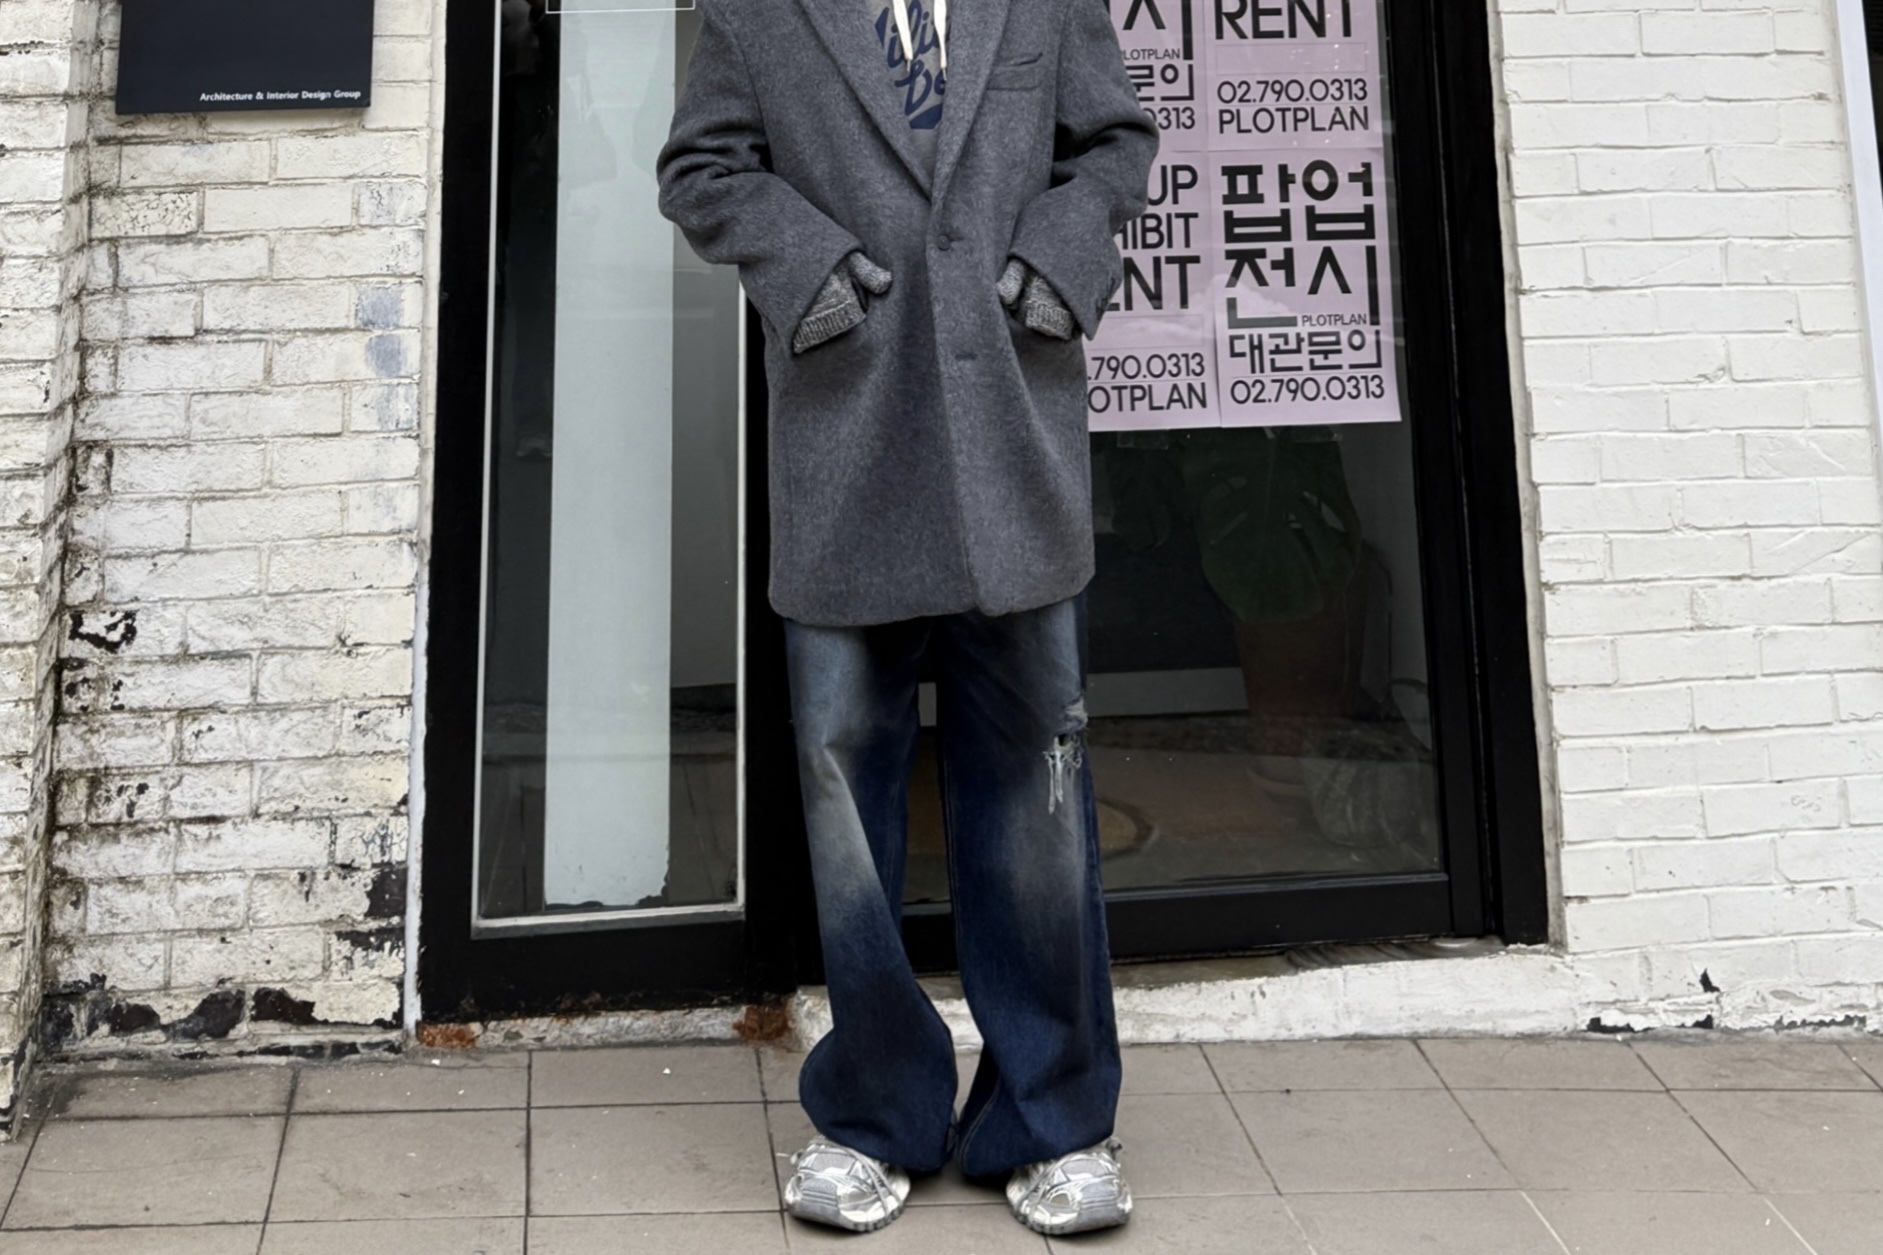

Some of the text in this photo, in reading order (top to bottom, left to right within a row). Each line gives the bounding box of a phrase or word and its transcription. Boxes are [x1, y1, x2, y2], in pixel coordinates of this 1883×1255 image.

[1121, 48, 1181, 61] LOTPLAN
[199, 89, 362, 102] Architecture & Interior Design Group
[1217, 78, 1368, 105] 02.790.0313
[1218, 105, 1370, 135] PLOTPLAN
[1221, 159, 1376, 244] 팝업
[1106, 255, 1201, 311] NT
[1225, 245, 1381, 330] 전시
[1301, 313, 1367, 327] PLOTPLAN
[1087, 381, 1207, 413] OTPLAN
[1230, 374, 1385, 405] 02.790.0313
